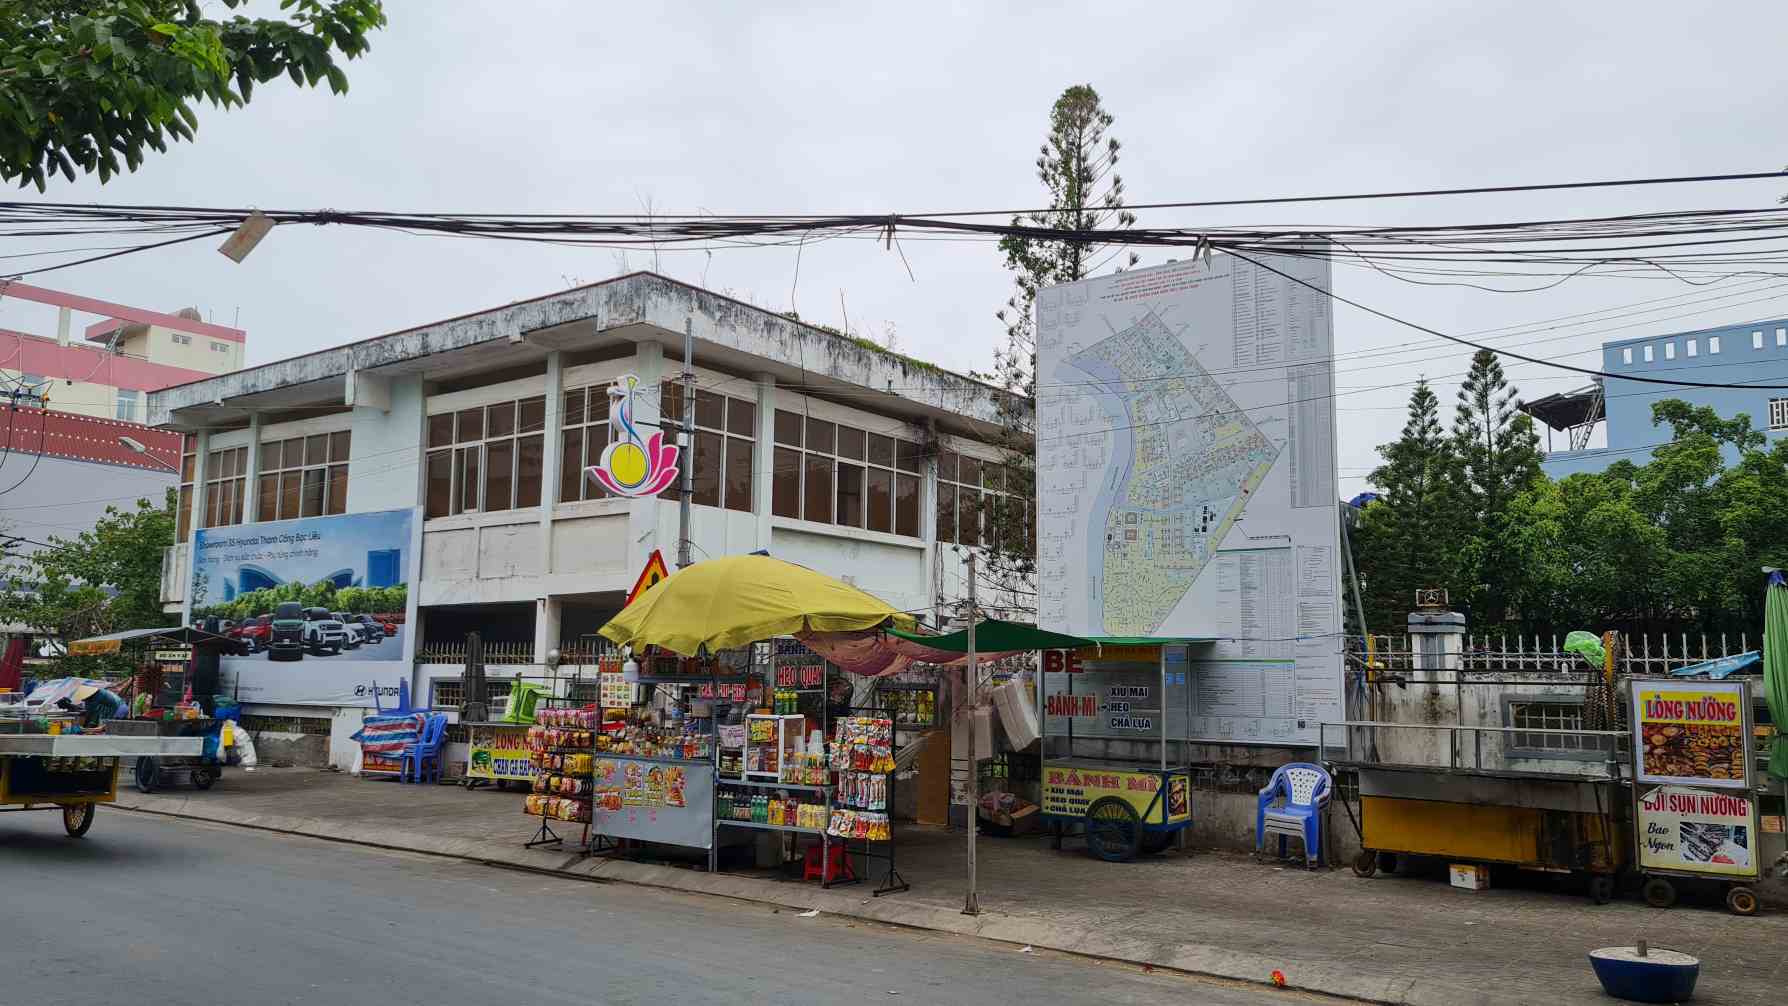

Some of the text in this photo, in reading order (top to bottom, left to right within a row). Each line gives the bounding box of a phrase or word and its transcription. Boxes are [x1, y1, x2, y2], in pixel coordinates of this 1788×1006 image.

[777, 665, 797, 687] HEO
[368, 686, 401, 697] HYUNDA
[1110, 702, 1129, 712] HEO
